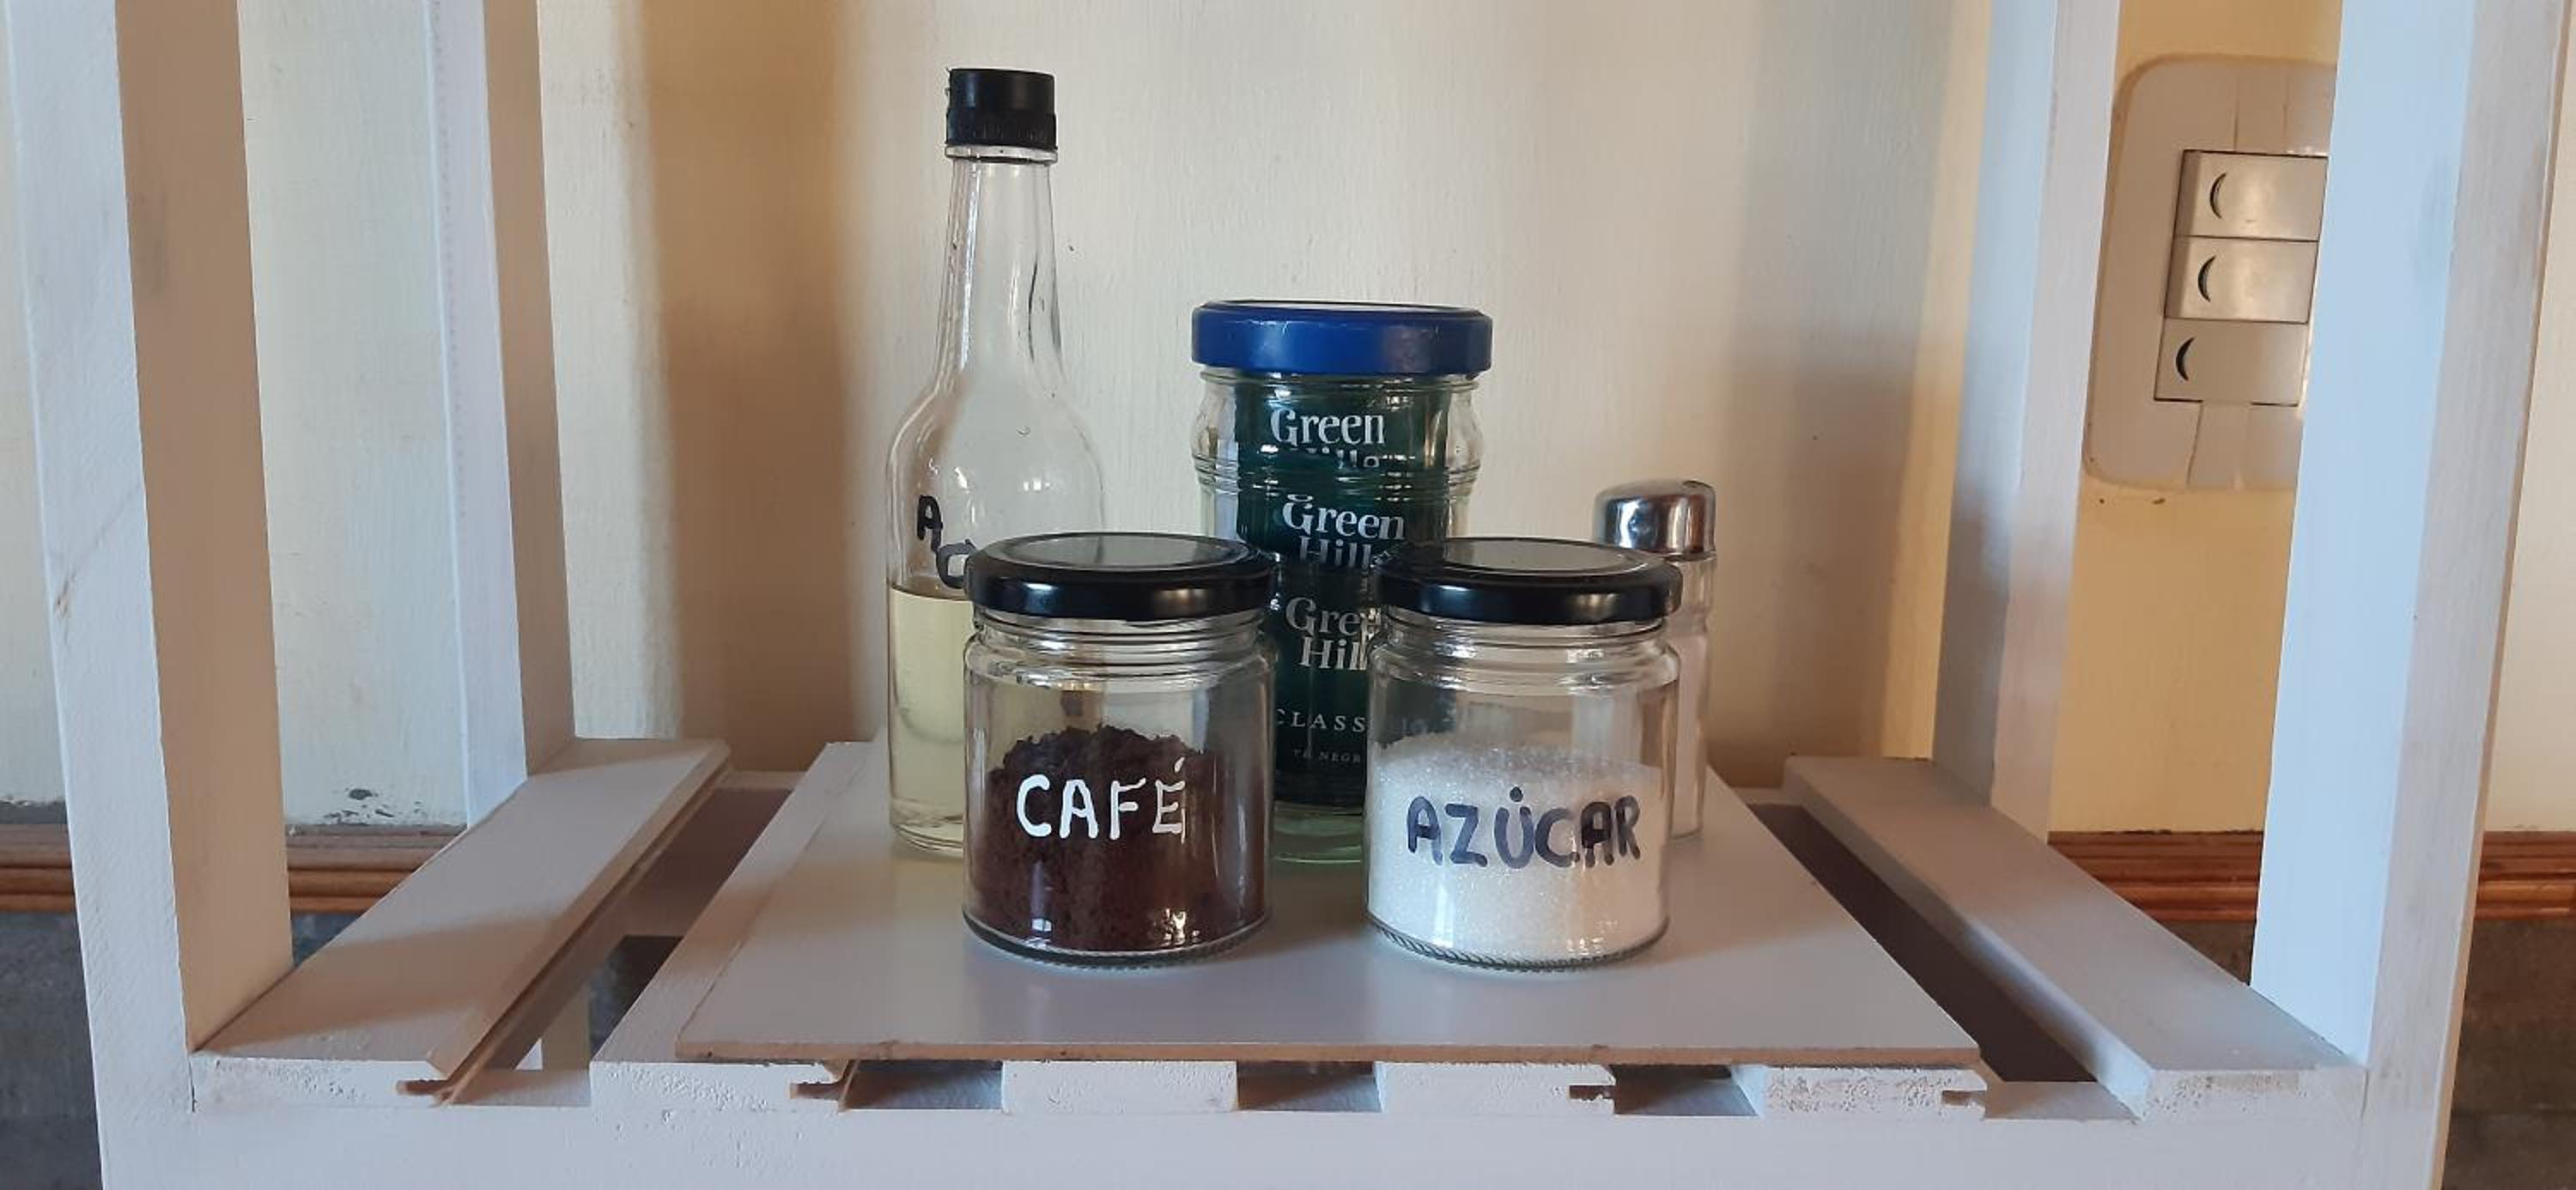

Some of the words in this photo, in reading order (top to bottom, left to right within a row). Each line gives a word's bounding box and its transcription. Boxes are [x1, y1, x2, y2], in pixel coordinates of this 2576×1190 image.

[1271, 409, 1385, 447] Green
[1282, 501, 1406, 540] Green
[1299, 536, 1372, 566] Hill
[1286, 597, 1364, 637] Gre
[1299, 636, 1367, 671] Hill
[1017, 756, 1185, 840] CAFÉ
[1406, 786, 1641, 869] AZÚCAR
